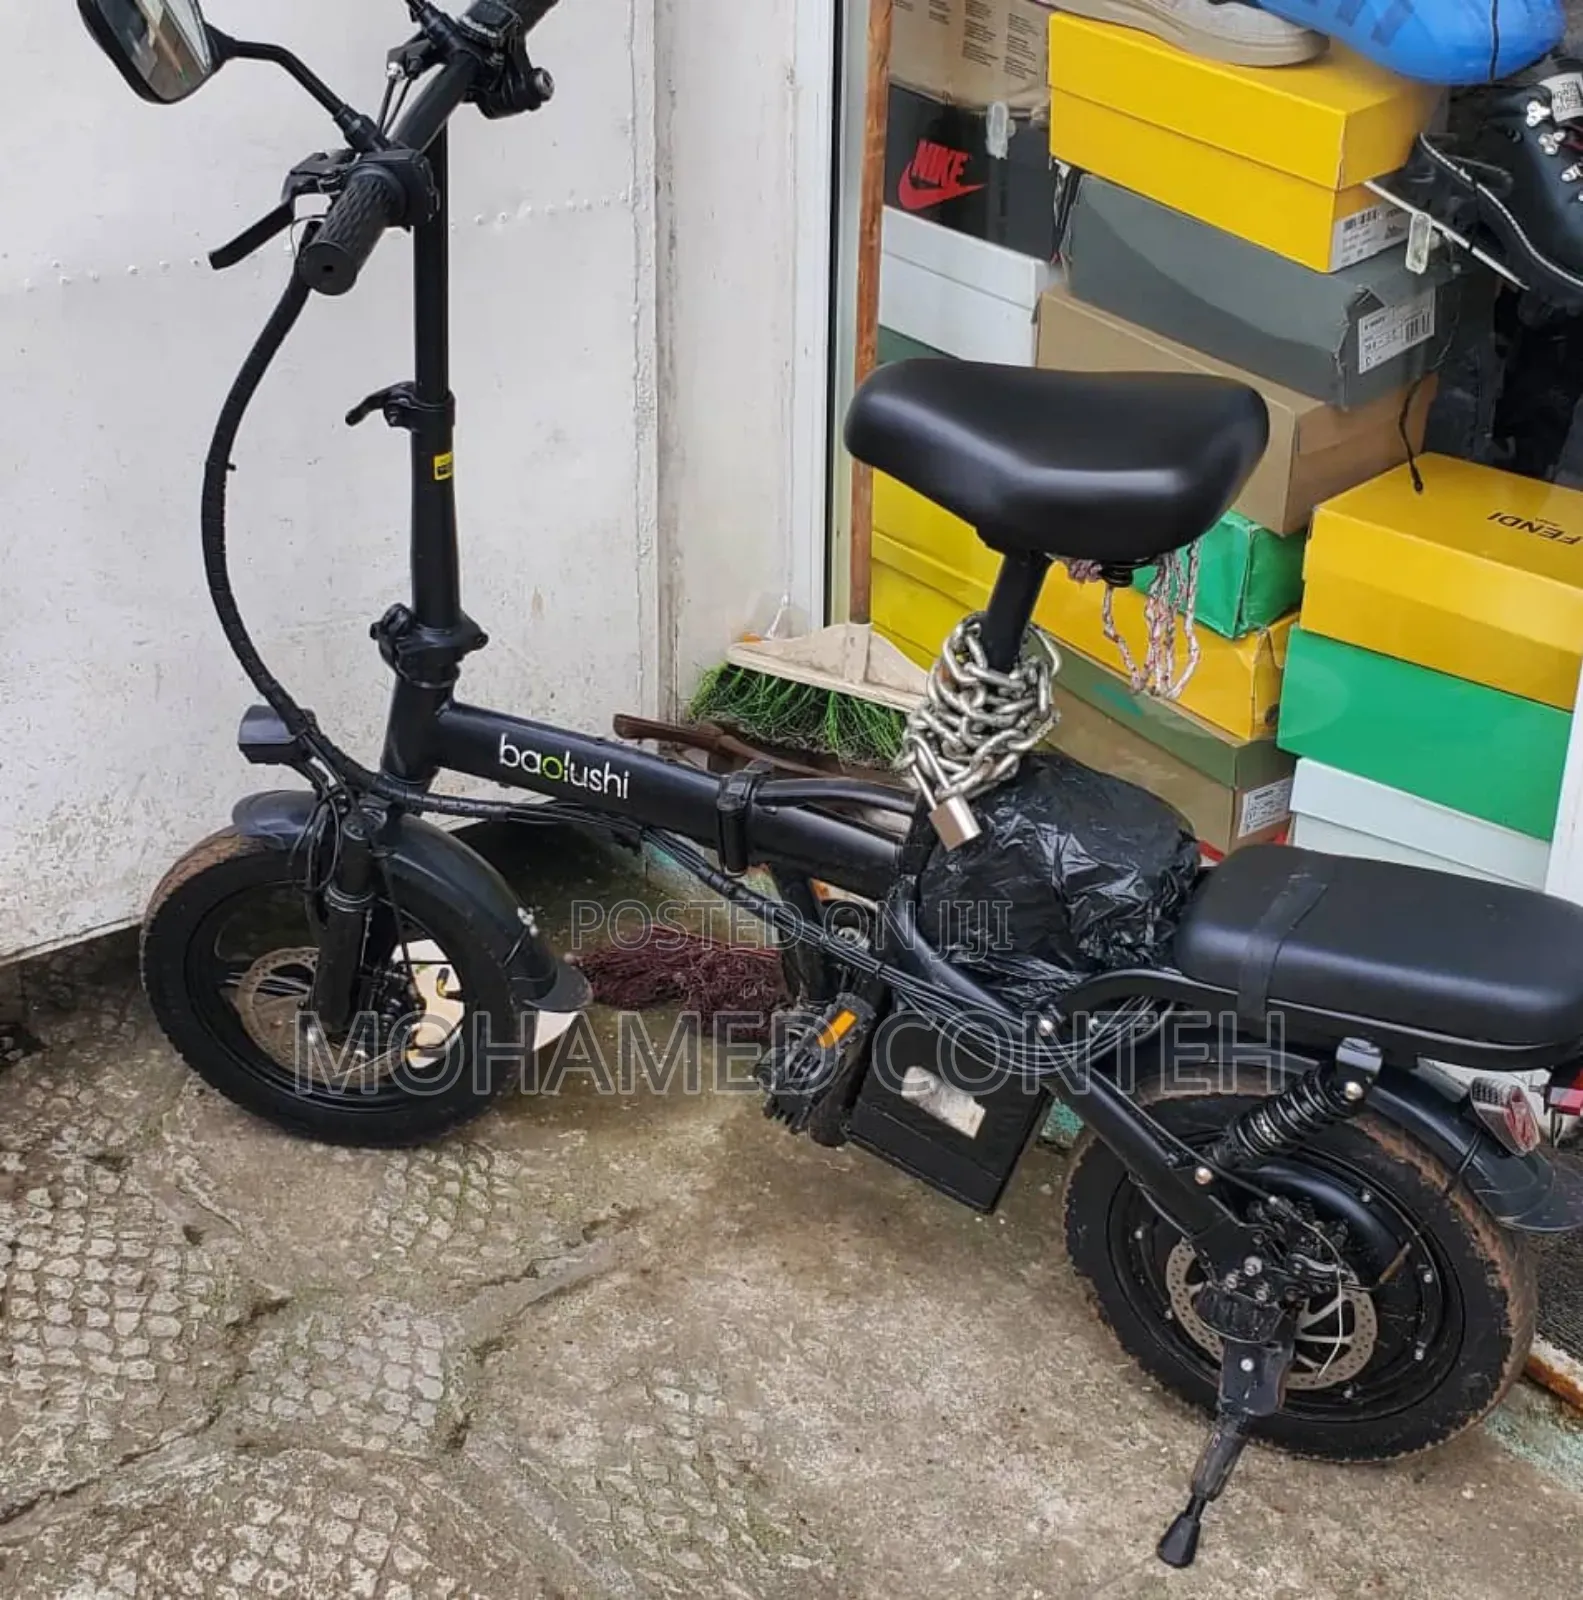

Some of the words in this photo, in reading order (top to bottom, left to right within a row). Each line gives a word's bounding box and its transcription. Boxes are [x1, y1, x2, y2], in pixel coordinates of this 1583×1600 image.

[911, 139, 969, 187] NIKE
[1487, 512, 1583, 545] FENDI
[499, 732, 629, 799] baolushi
